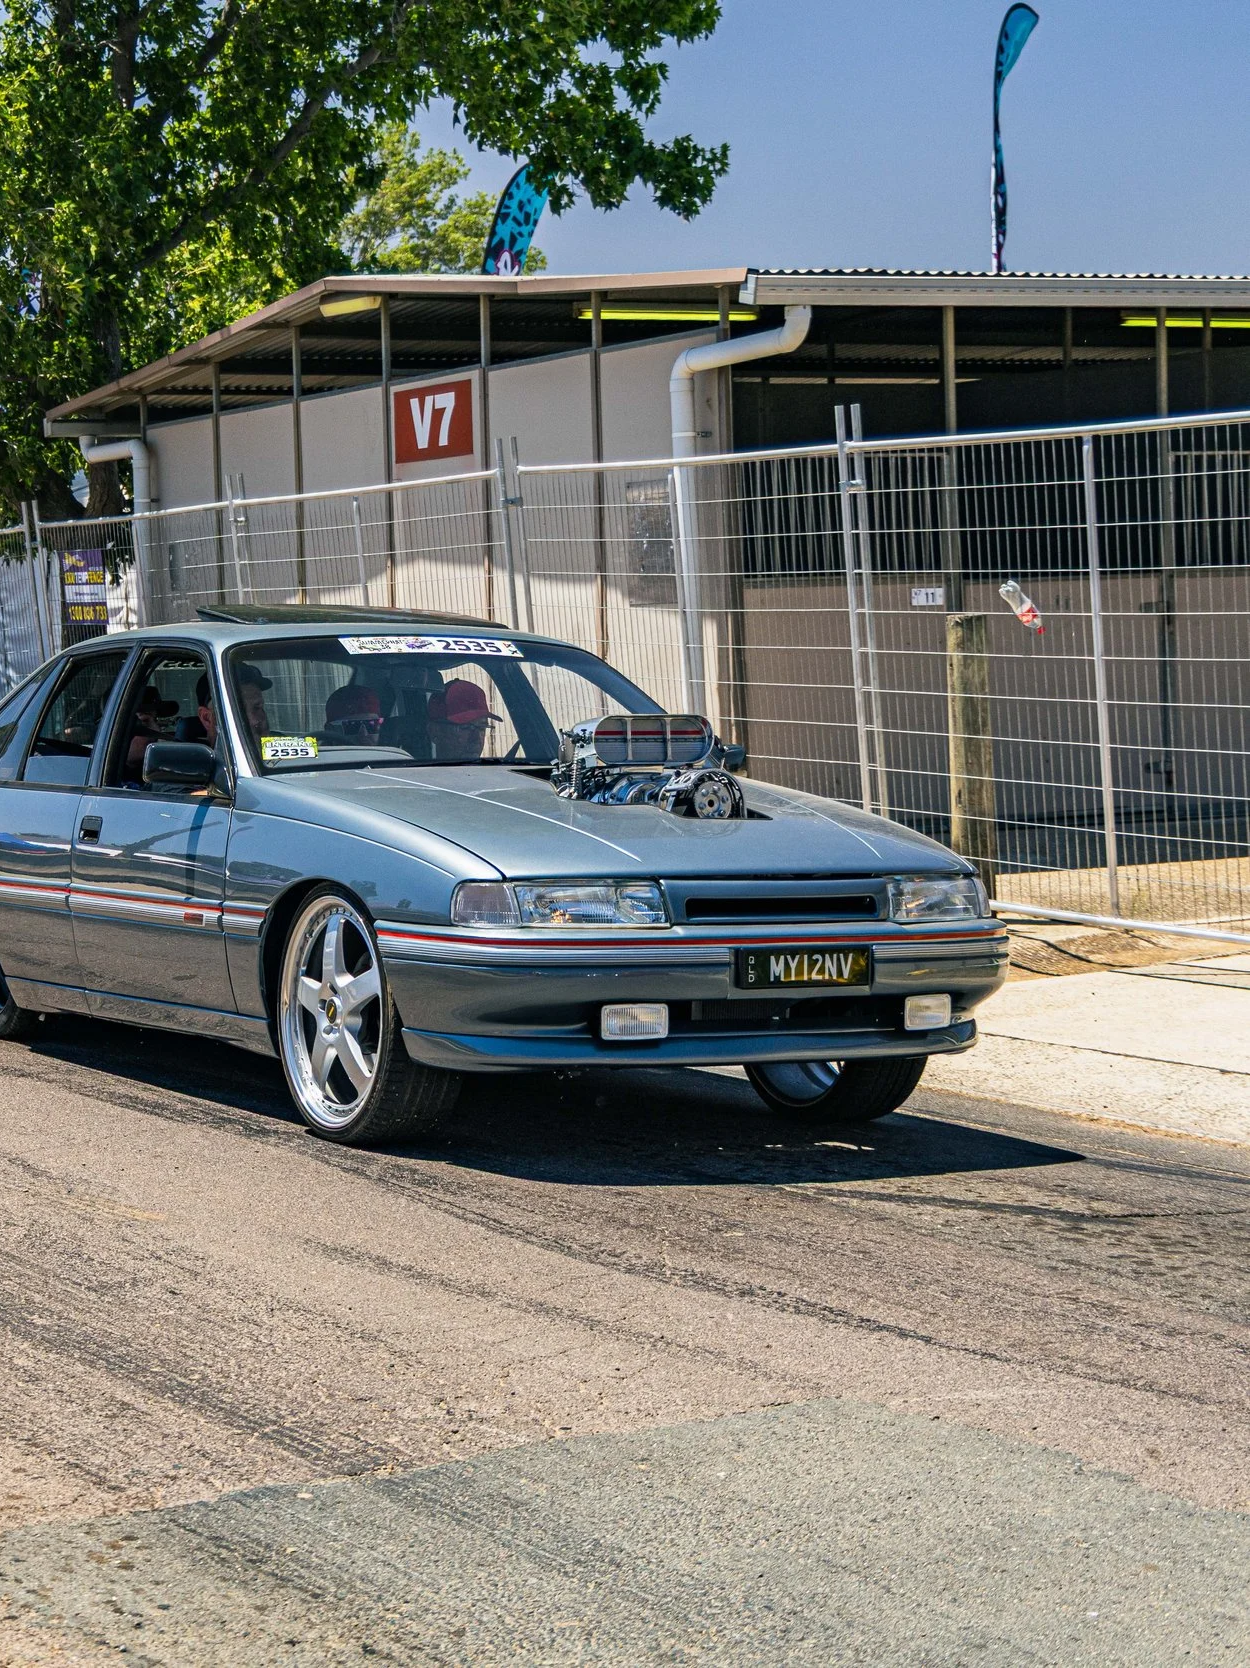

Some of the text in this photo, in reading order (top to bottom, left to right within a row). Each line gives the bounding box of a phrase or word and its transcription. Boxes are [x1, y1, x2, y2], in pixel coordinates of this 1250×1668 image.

[410, 392, 455, 449] V7
[436, 639, 502, 653] 2535
[270, 748, 310, 757] 2535
